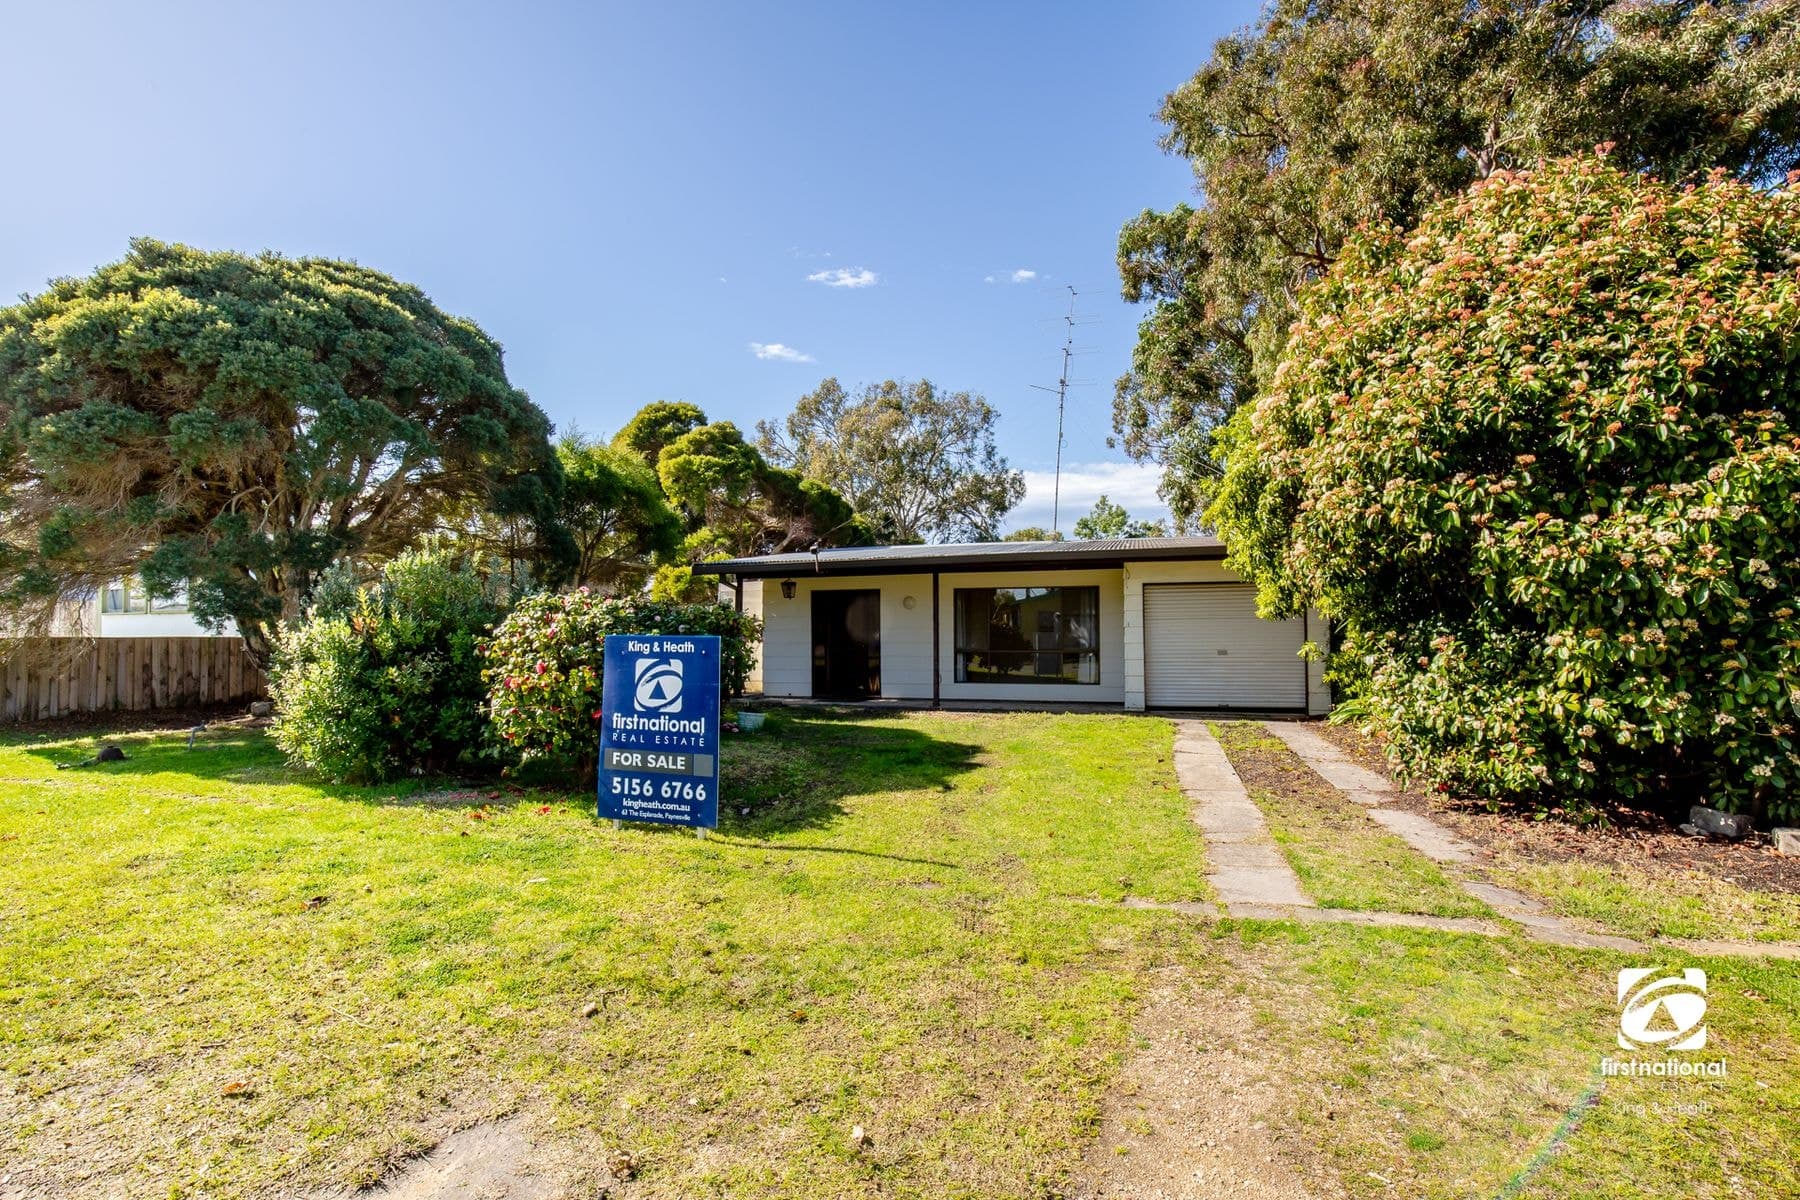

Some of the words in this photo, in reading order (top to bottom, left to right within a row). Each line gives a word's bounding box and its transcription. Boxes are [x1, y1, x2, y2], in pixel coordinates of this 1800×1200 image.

[628, 641, 650, 654] King
[652, 642, 660, 653] &
[663, 641, 695, 653] Heath
[612, 713, 705, 734] firstnational
[612, 732, 645, 743] REAL
[655, 735, 705, 747] ESTATE
[612, 752, 642, 767] FOR
[647, 754, 686, 770] SALE
[611, 777, 653, 797] 5156
[661, 781, 706, 801] 6766
[622, 798, 691, 811] kingheath.com.au
[629, 809, 639, 817] The
